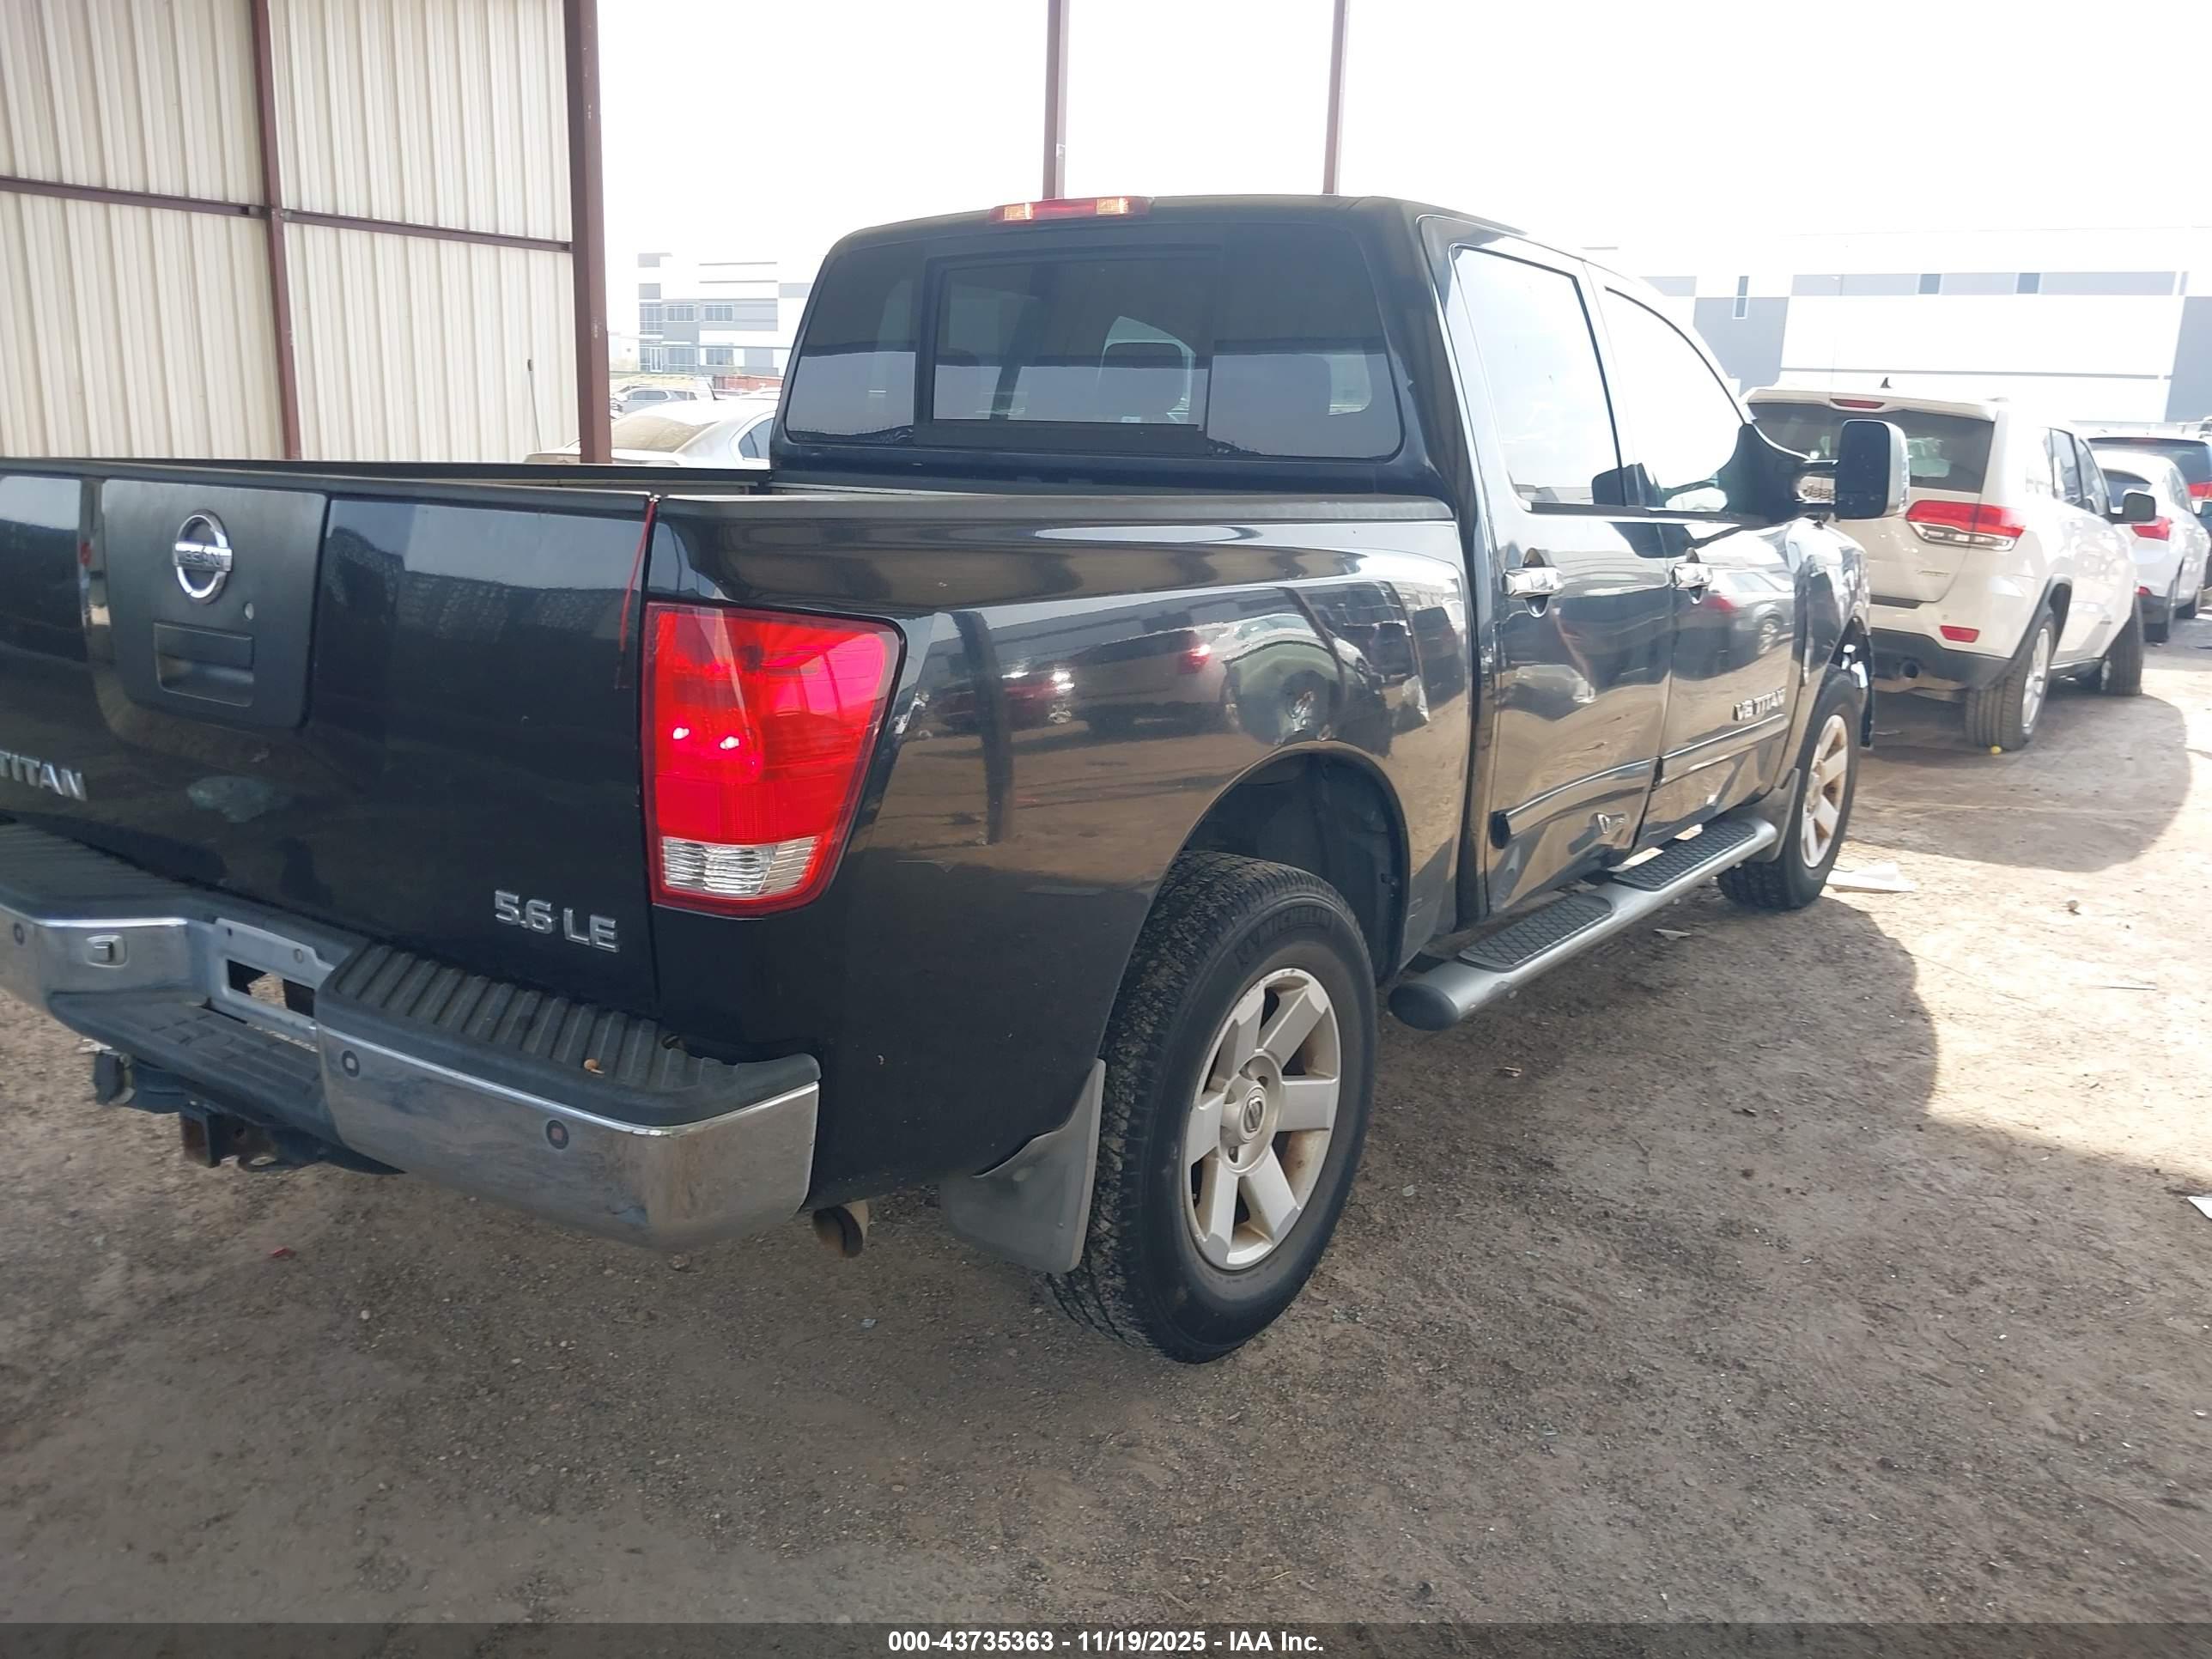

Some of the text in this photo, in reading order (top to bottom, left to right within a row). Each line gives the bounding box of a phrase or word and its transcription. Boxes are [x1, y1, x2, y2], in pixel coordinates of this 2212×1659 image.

[0, 750, 88, 802] TITAN
[495, 890, 620, 953] 5.6 LE
